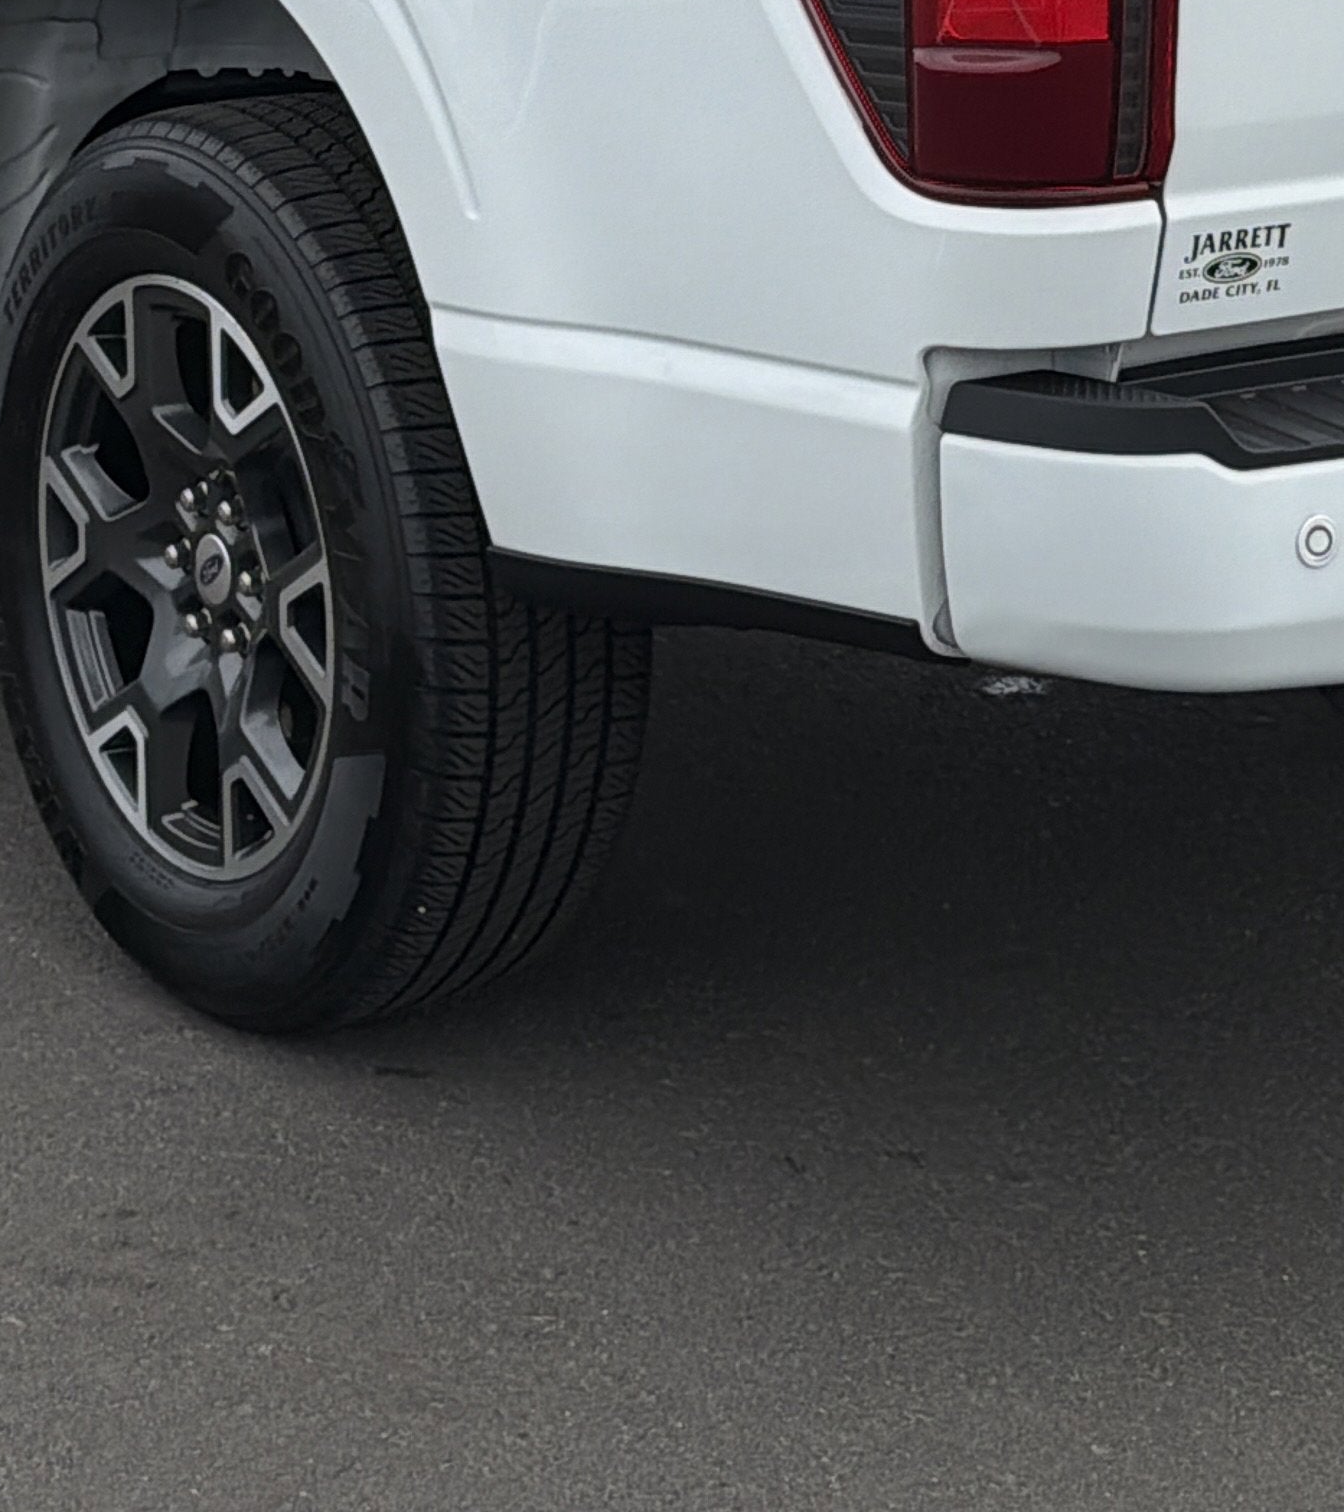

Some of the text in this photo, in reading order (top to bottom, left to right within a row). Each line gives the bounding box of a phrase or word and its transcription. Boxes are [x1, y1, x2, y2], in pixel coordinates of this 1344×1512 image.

[1184, 223, 1291, 264] JARRETT
[2, 196, 98, 326] TERRITORY
[1179, 268, 1201, 280] EST.
[1263, 256, 1289, 268] 1978
[1179, 279, 1280, 304] DADE CITY, FL
